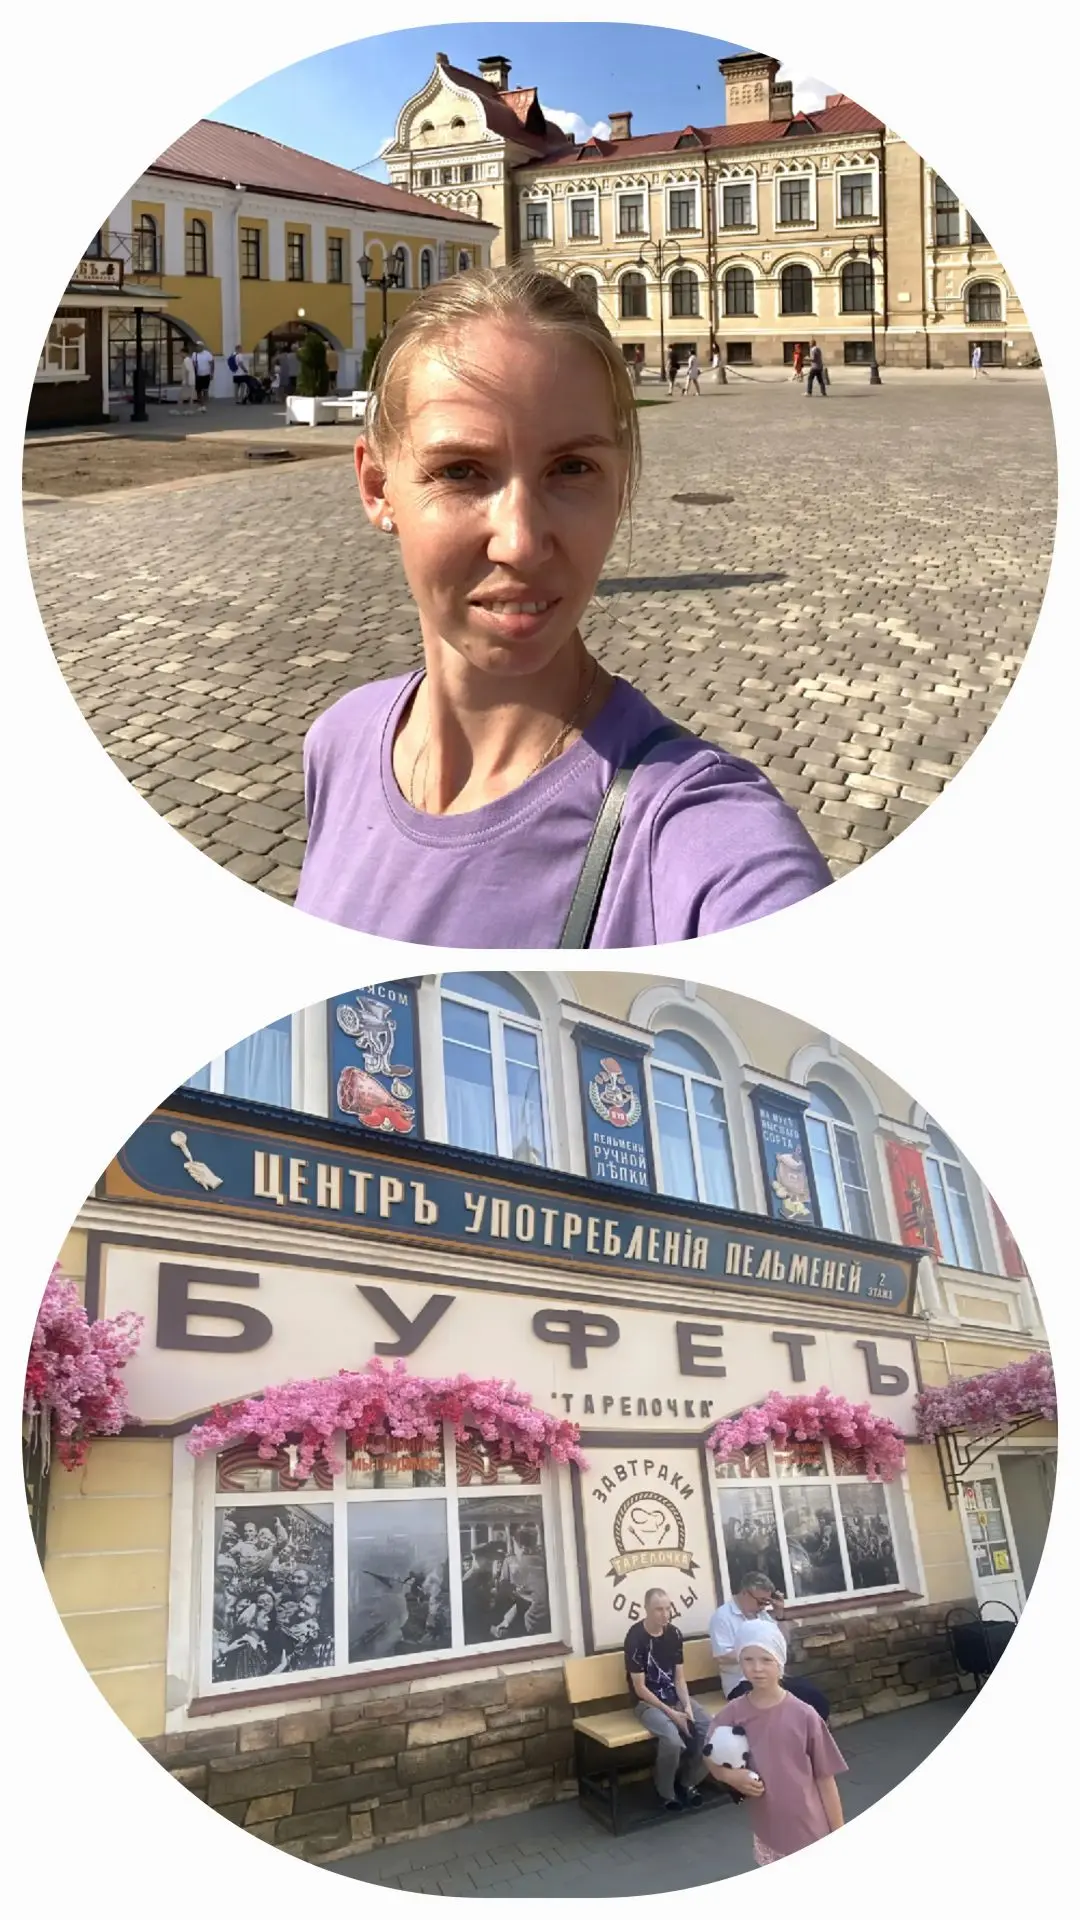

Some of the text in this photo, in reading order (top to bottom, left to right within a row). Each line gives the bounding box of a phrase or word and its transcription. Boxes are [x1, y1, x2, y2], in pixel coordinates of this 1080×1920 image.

[361, 984, 409, 1007] ЯСОМ
[594, 1132, 644, 1154] ПЕЛЬМЕНИ
[763, 1130, 794, 1150] СОРТА
[594, 1145, 647, 1170] РУЧНОЙ
[253, 1149, 439, 1226] ЦЕНТРЪ
[725, 1241, 862, 1295] ПЕЛЬМЕНЕЙ
[879, 1272, 887, 1287] 2
[156, 1261, 910, 1397] БУФЕТЪ
[592, 1459, 694, 1504] ЗАВТРАКИ
[614, 1552, 690, 1571] ТАРЕЛОЧКА
[613, 1586, 699, 1622] ОБДЫ
